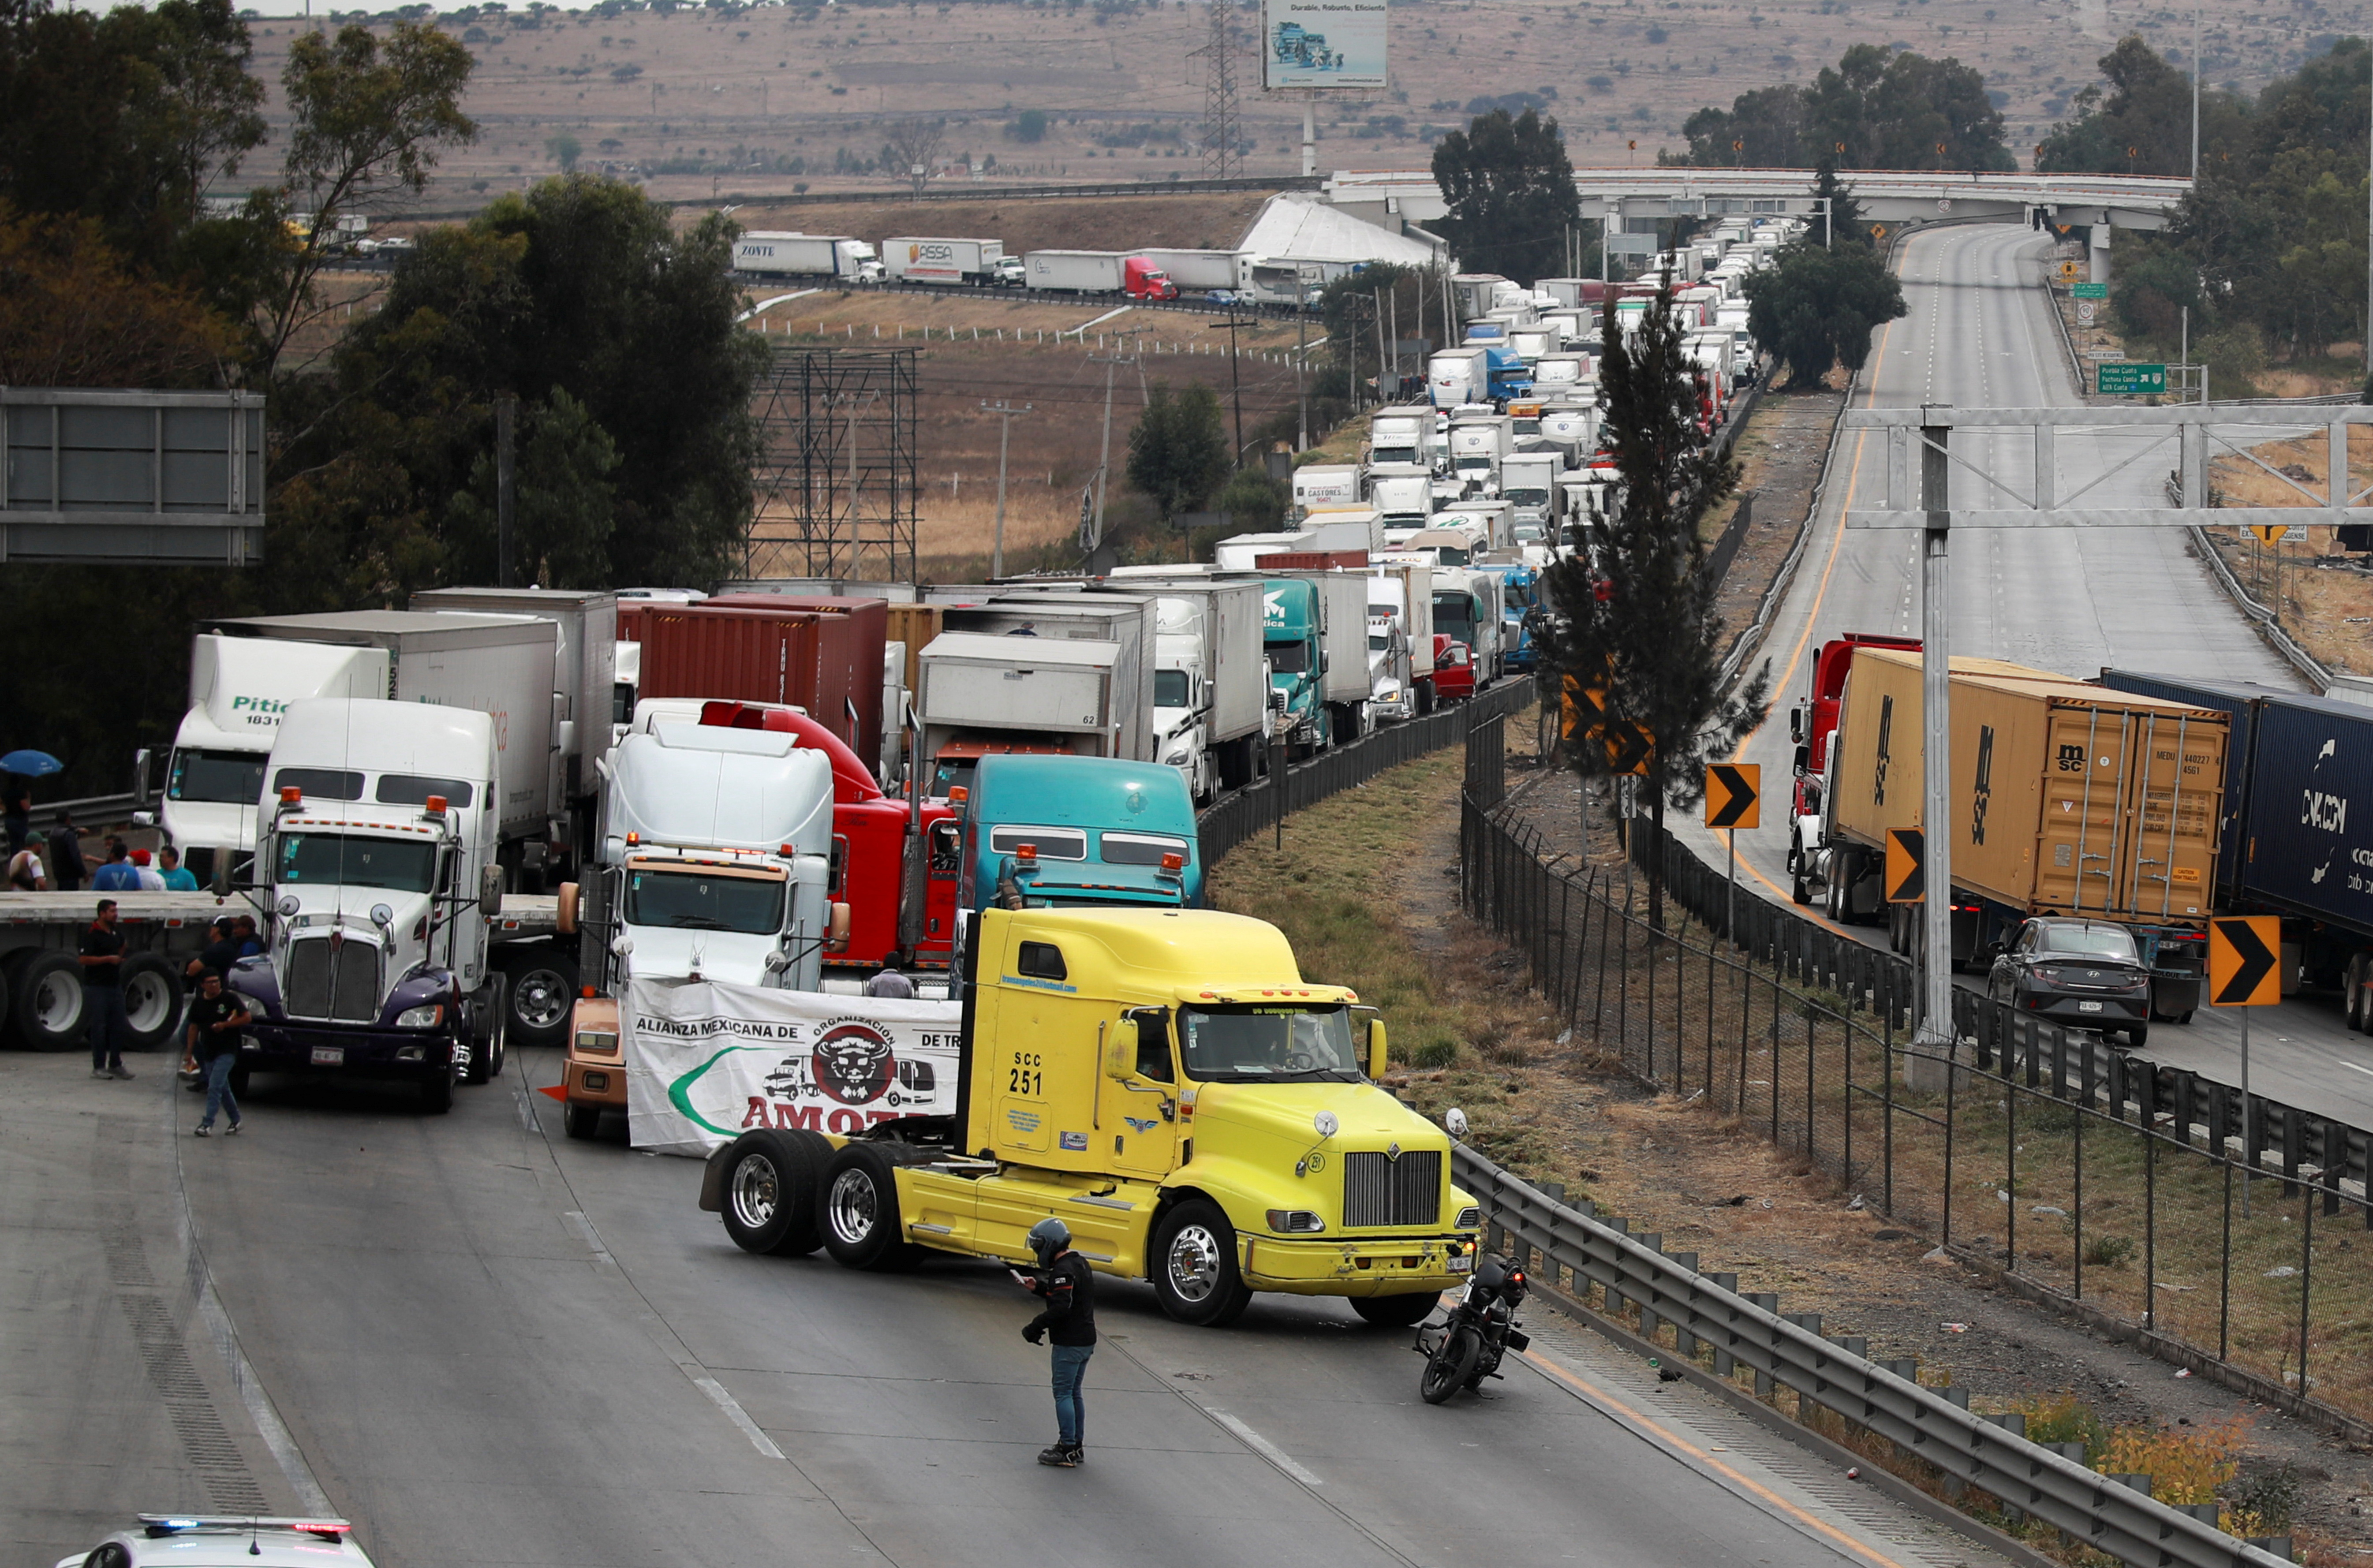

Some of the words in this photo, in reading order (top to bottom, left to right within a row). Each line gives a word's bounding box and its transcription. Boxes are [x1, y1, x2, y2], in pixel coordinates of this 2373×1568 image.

[742, 246, 775, 256] ZONTE
[919, 245, 953, 260] ASSA
[1083, 716, 1095, 724] 62
[2156, 751, 2175, 761] MEDU
[2184, 754, 2209, 764] 440227
[2183, 765, 2200, 775] 45G1
[636, 1017, 698, 1035] ALIANZA
[701, 1019, 772, 1038] MEXICANA
[777, 1026, 798, 1038] DE
[813, 1015, 895, 1045] ORGANIZACIÓN
[922, 1034, 940, 1047] DE
[1009, 1068, 1042, 1095] 251
[1312, 1156, 1321, 1169] 251
